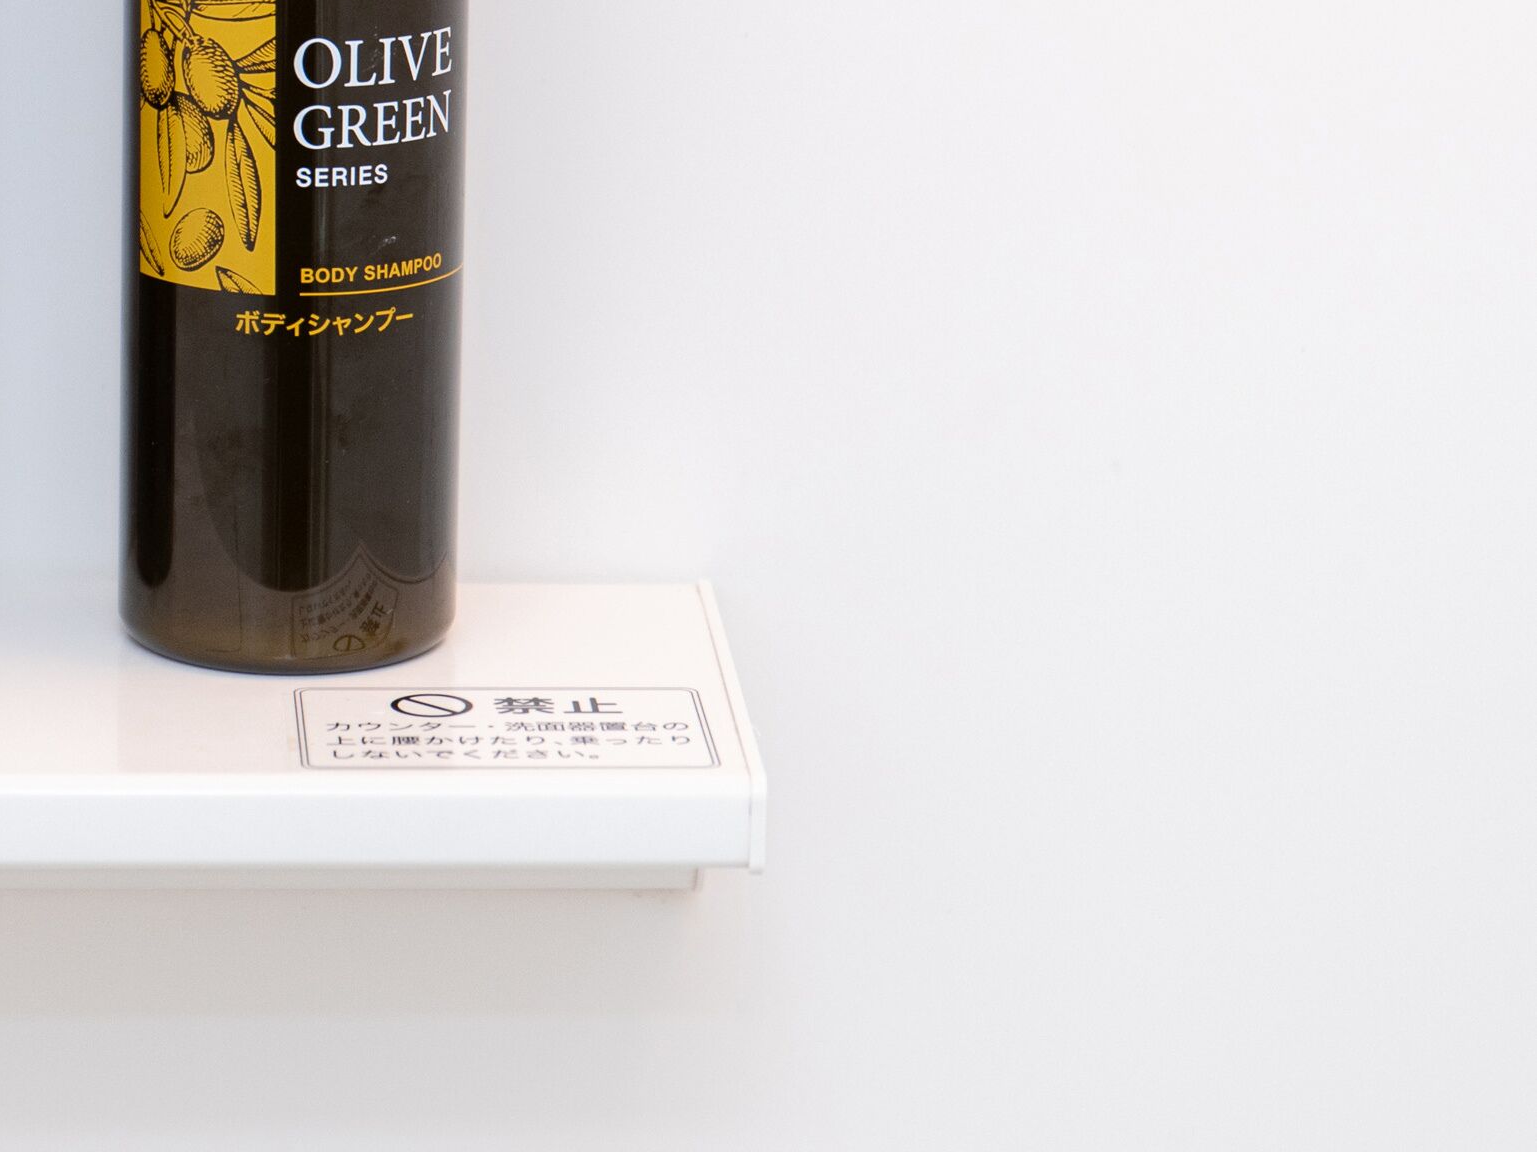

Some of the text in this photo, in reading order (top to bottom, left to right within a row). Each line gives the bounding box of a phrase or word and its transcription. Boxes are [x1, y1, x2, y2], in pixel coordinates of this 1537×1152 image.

[293, 26, 453, 89] OLIVE
[293, 89, 452, 150] GREEN
[295, 163, 388, 188] SERIES
[300, 253, 442, 284] BODY SHAMPOO
[235, 307, 414, 337] ボディシャンプー
[493, 696, 624, 715] 禁止
[332, 749, 599, 760] しないでください。
